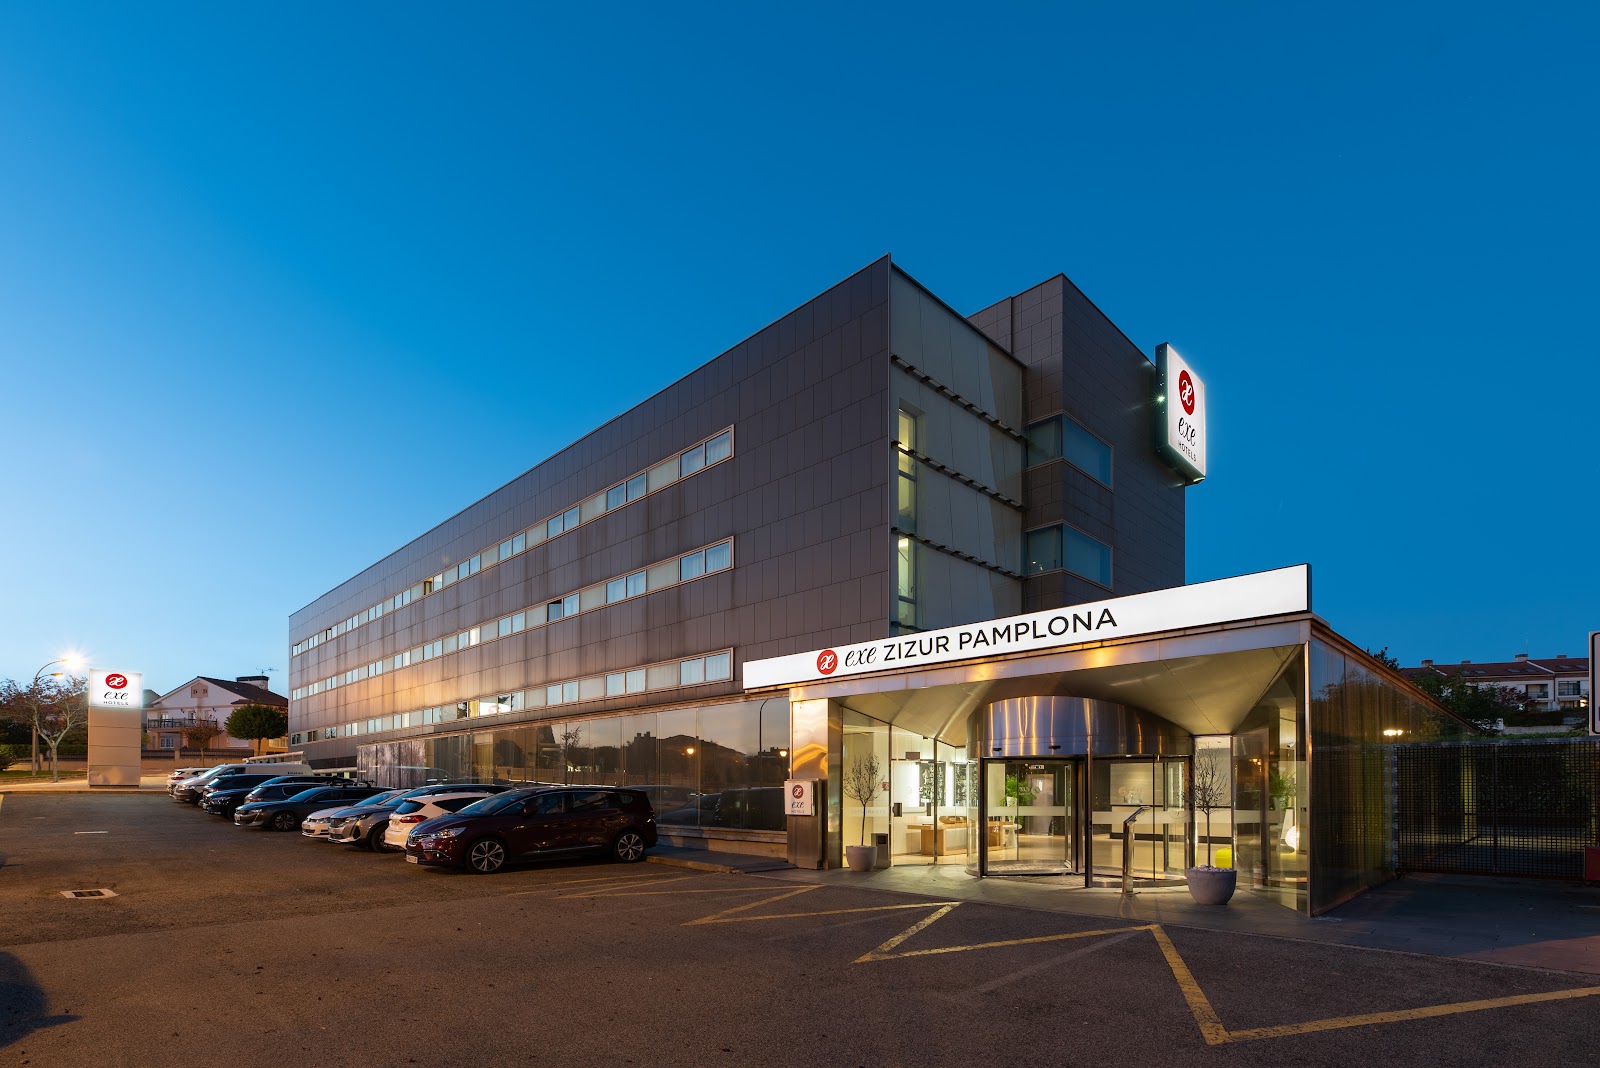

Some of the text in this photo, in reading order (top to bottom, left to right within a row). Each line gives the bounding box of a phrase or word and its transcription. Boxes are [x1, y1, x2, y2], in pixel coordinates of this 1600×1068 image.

[1178, 417, 1196, 446] exe
[1178, 441, 1196, 461] HOTELS
[845, 608, 1118, 667] exe ZIZUR PAMPLONA
[104, 691, 129, 700] exe
